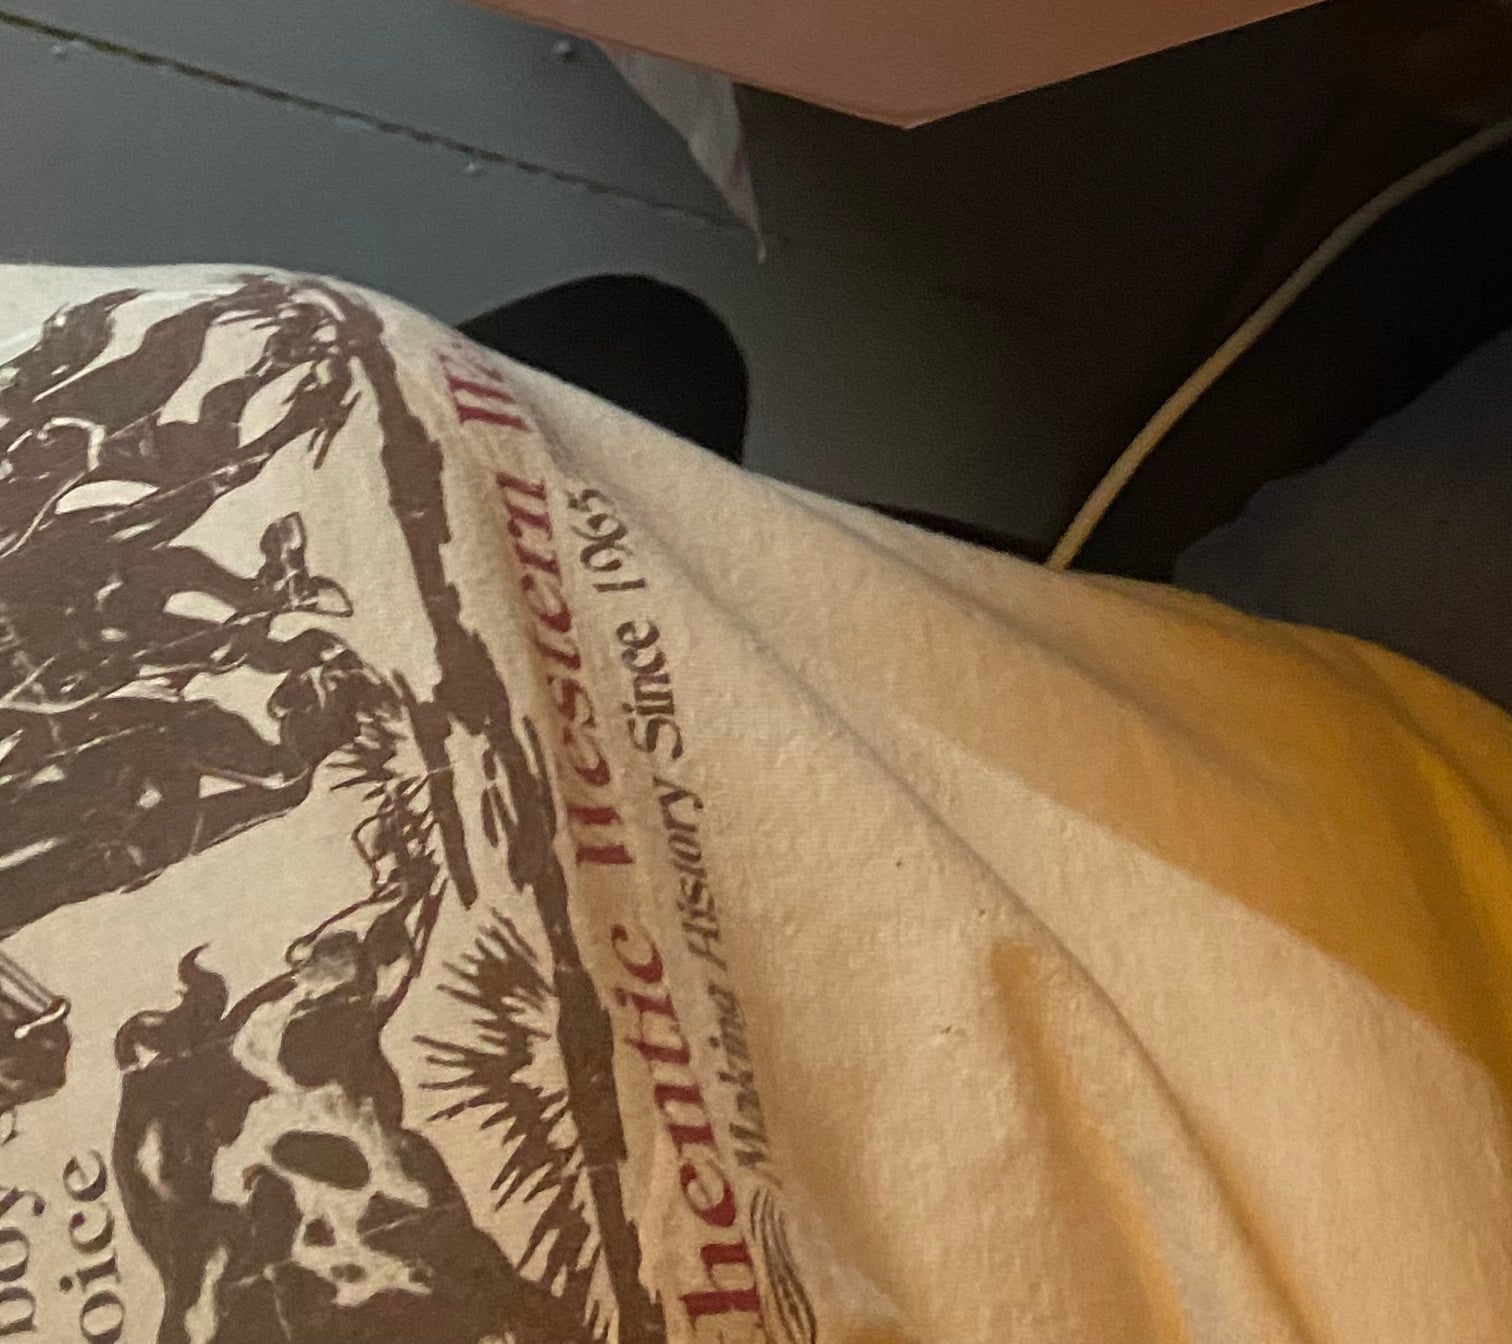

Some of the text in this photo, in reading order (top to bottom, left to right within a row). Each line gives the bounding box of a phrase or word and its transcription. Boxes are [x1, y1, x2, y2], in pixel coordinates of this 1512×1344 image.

[568, 488, 648, 594] 1965
[496, 471, 635, 865] Western
[615, 618, 684, 761] Since
[652, 775, 729, 972] History
[609, 922, 772, 1344] hentic
